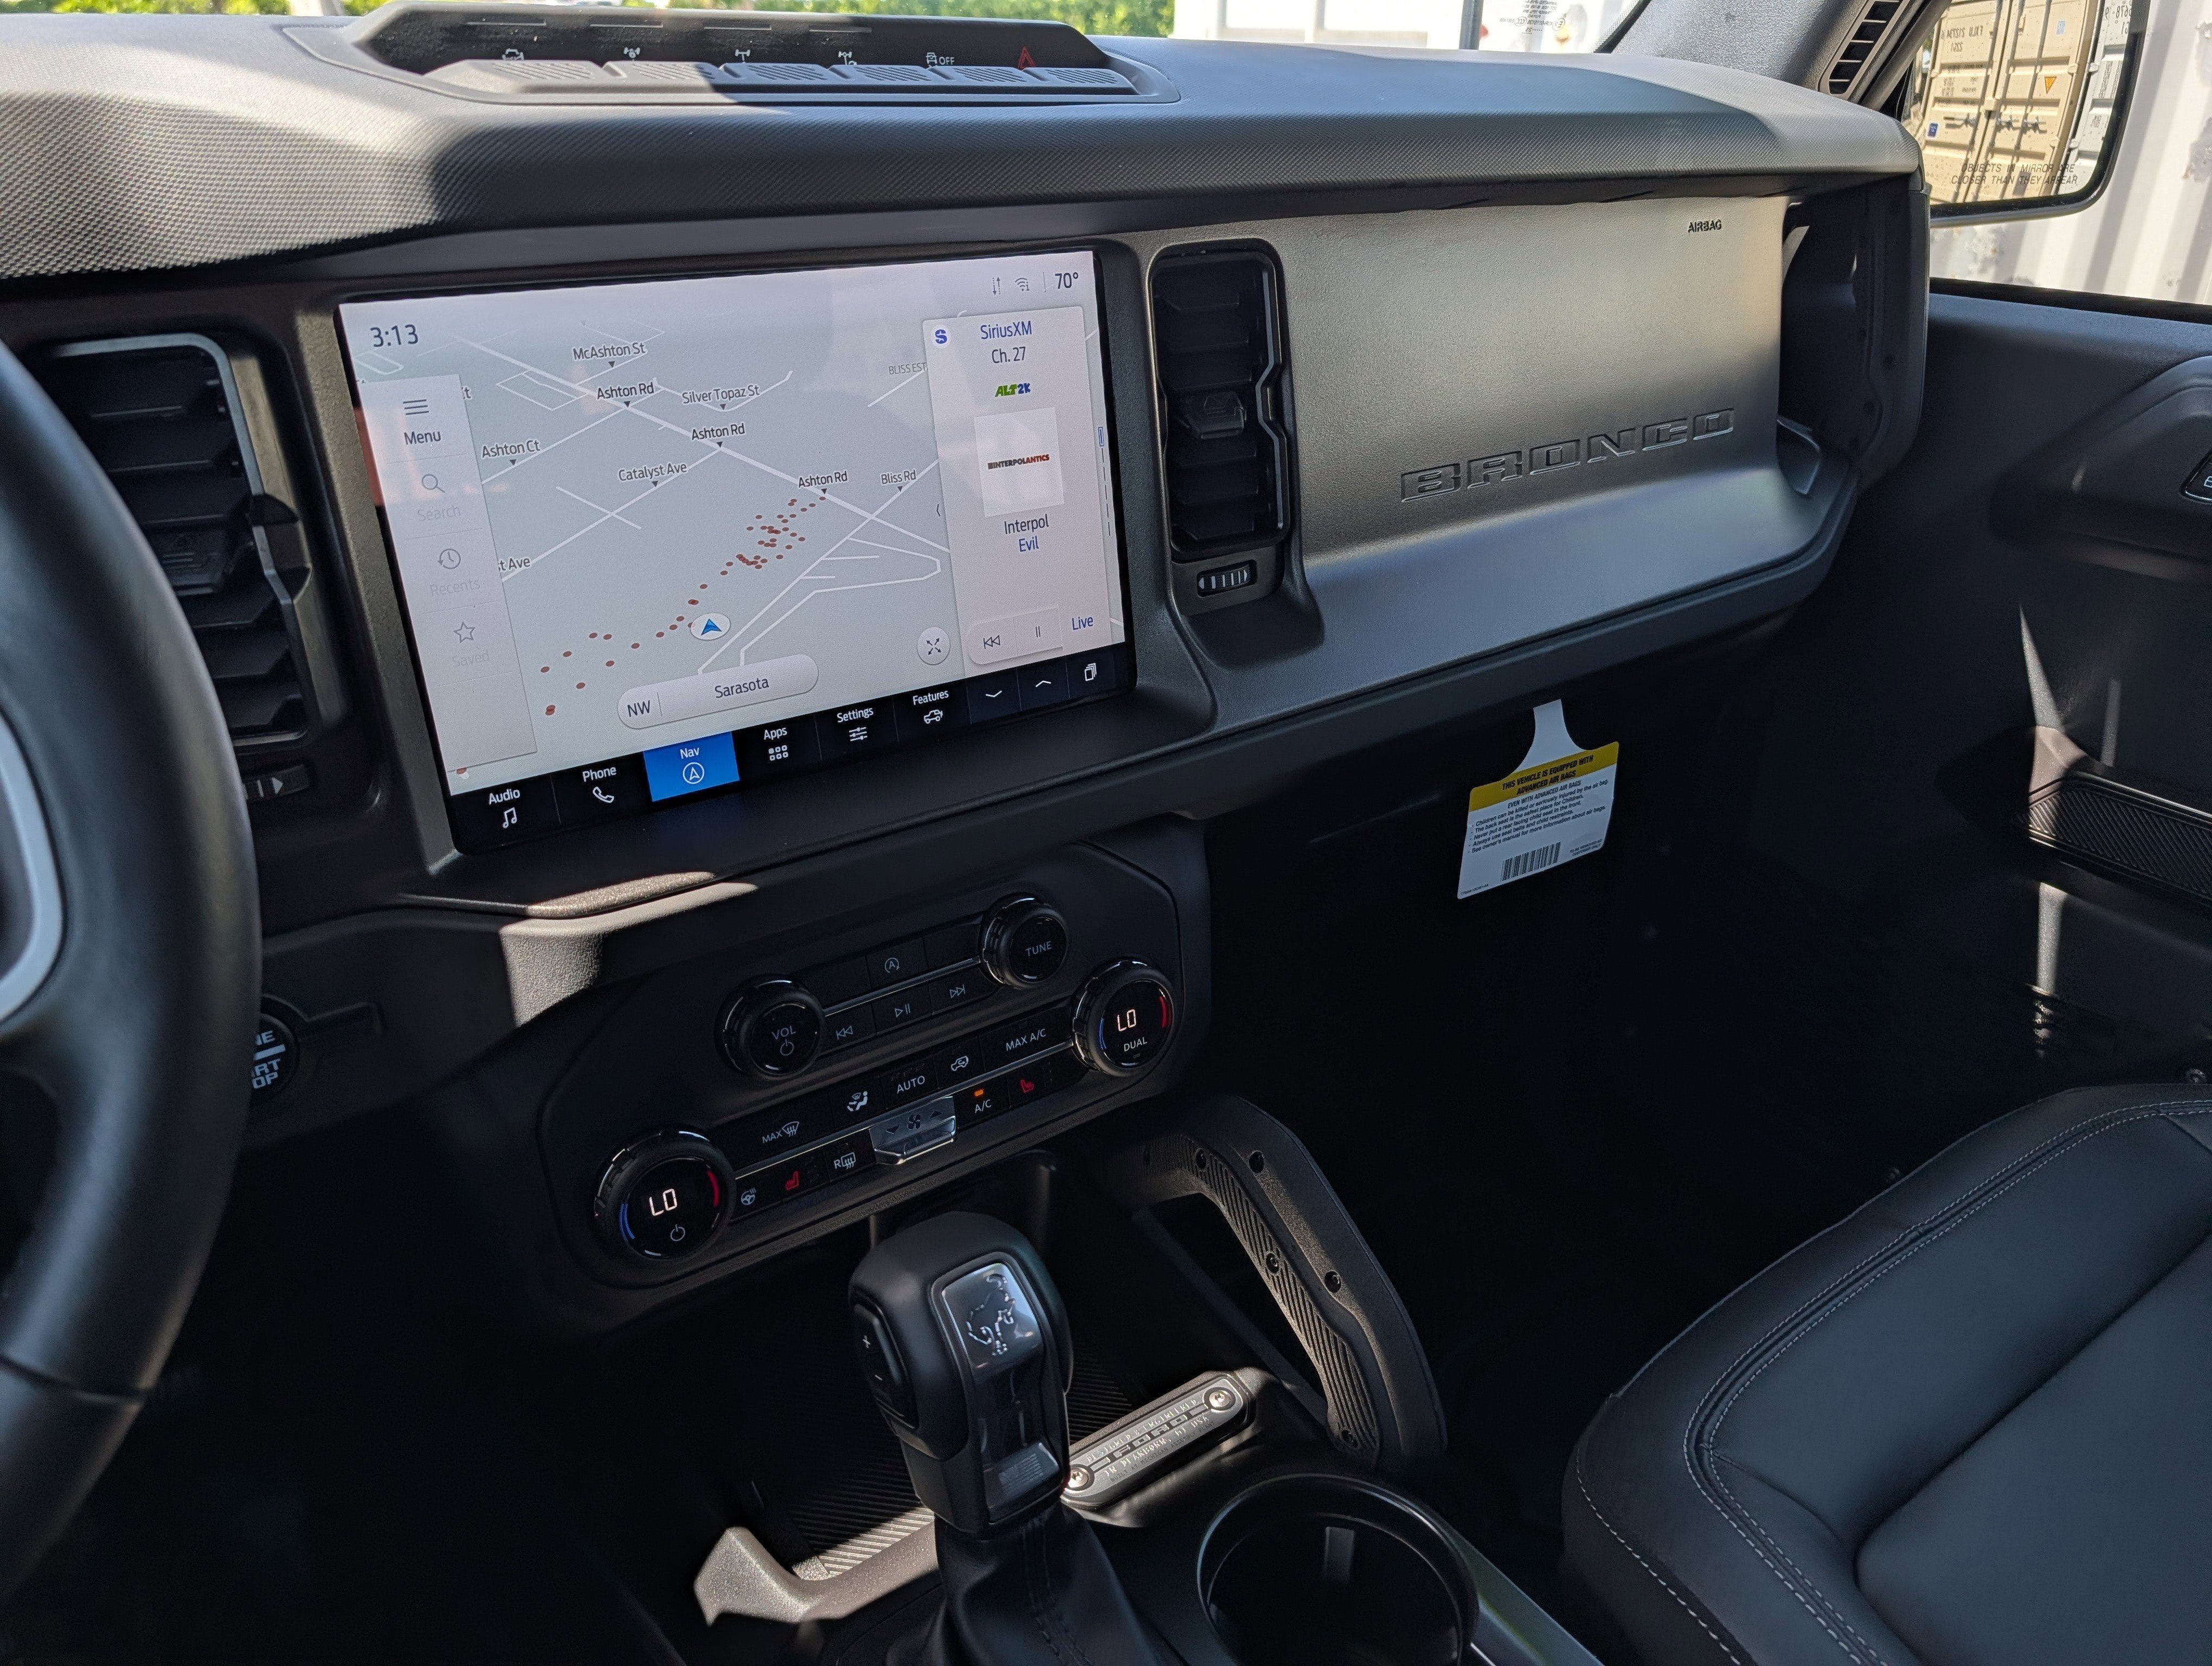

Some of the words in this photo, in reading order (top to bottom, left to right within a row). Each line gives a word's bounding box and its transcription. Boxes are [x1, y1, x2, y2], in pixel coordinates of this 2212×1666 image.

[938, 56, 955, 65] OFF
[1962, 163, 2002, 173] OBJECTS
[2007, 163, 2016, 172] IN
[2020, 163, 2054, 172] MIRROR
[1952, 175, 1986, 184] CLOSER
[1991, 175, 2015, 184] THAN
[2020, 175, 2041, 184] THEY
[2044, 175, 2078, 184] APPEAR
[1688, 219, 1722, 234] AIRBAG
[1054, 272, 1078, 289] 70°
[370, 324, 419, 347] 3:13
[980, 321, 1032, 339] SiriusXM
[573, 346, 630, 361] McAshton
[631, 342, 646, 354] St
[992, 348, 1010, 364] Ch.
[1013, 347, 1026, 361] 27
[889, 364, 910, 375] BLISS
[597, 385, 636, 400] Ashton
[637, 382, 655, 395] Rd
[681, 389, 712, 404] Silver
[713, 386, 745, 402] Topaz
[747, 385, 760, 396] St
[995, 383, 1031, 397] ALT2K
[404, 431, 441, 445] Menu
[691, 426, 729, 440] Ashton
[731, 423, 745, 435] Rd
[482, 441, 525, 458] Ashton
[527, 440, 541, 451] Ct
[1401, 408, 1734, 503] BRONCO
[619, 463, 664, 482] Catalyst
[666, 461, 687, 474] Ave
[799, 472, 833, 488] Ashton
[835, 471, 848, 482] Rd
[881, 470, 902, 485] Bliss
[904, 470, 916, 480] Rd
[417, 505, 461, 522] Search
[1005, 514, 1049, 535] Interpol
[1019, 536, 1039, 552] Evil
[509, 558, 530, 570] Ave
[430, 579, 480, 596] Recents
[1072, 616, 1094, 631] Live
[452, 651, 490, 668] Saved
[715, 677, 769, 699] Sarasota
[912, 689, 949, 706] Features
[627, 701, 651, 717] NW
[837, 707, 873, 723] Settings
[763, 726, 787, 741] Apps
[680, 746, 699, 759] Nav
[582, 766, 616, 782] Phone
[1502, 780, 1515, 790] THIS
[1516, 772, 1541, 785] VEHICLE
[1549, 760, 1577, 774] EQUIPPED
[1578, 755, 1593, 765] WITH
[1516, 779, 1547, 794] ADVANCED
[1560, 770, 1576, 780] BAGS
[489, 788, 520, 805] Audio
[1508, 800, 1520, 808] EVEN
[1534, 787, 1558, 799] ADVANCED
[1568, 780, 1581, 788] BAGS
[1476, 816, 1496, 826] Children
[1026, 941, 1052, 957] TUNE
[1116, 1009, 1137, 1031] LO
[771, 1025, 796, 1041] VOL
[1005, 1034, 1028, 1052] MAX
[1030, 1029, 1046, 1043] A/C
[1123, 1036, 1148, 1052] DUAL
[252, 1072, 279, 1089] OP
[896, 1075, 925, 1094] AUTO
[974, 1099, 992, 1113] A/C
[762, 1130, 783, 1143] MAX
[649, 1188, 678, 1217] LO
[1110, 1469, 1128, 1482] BUILT
[1129, 1464, 1138, 1472] AT
[1140, 1447, 1168, 1463] MICHIGAN
[1171, 1432, 1196, 1447] ASSEMBLY
